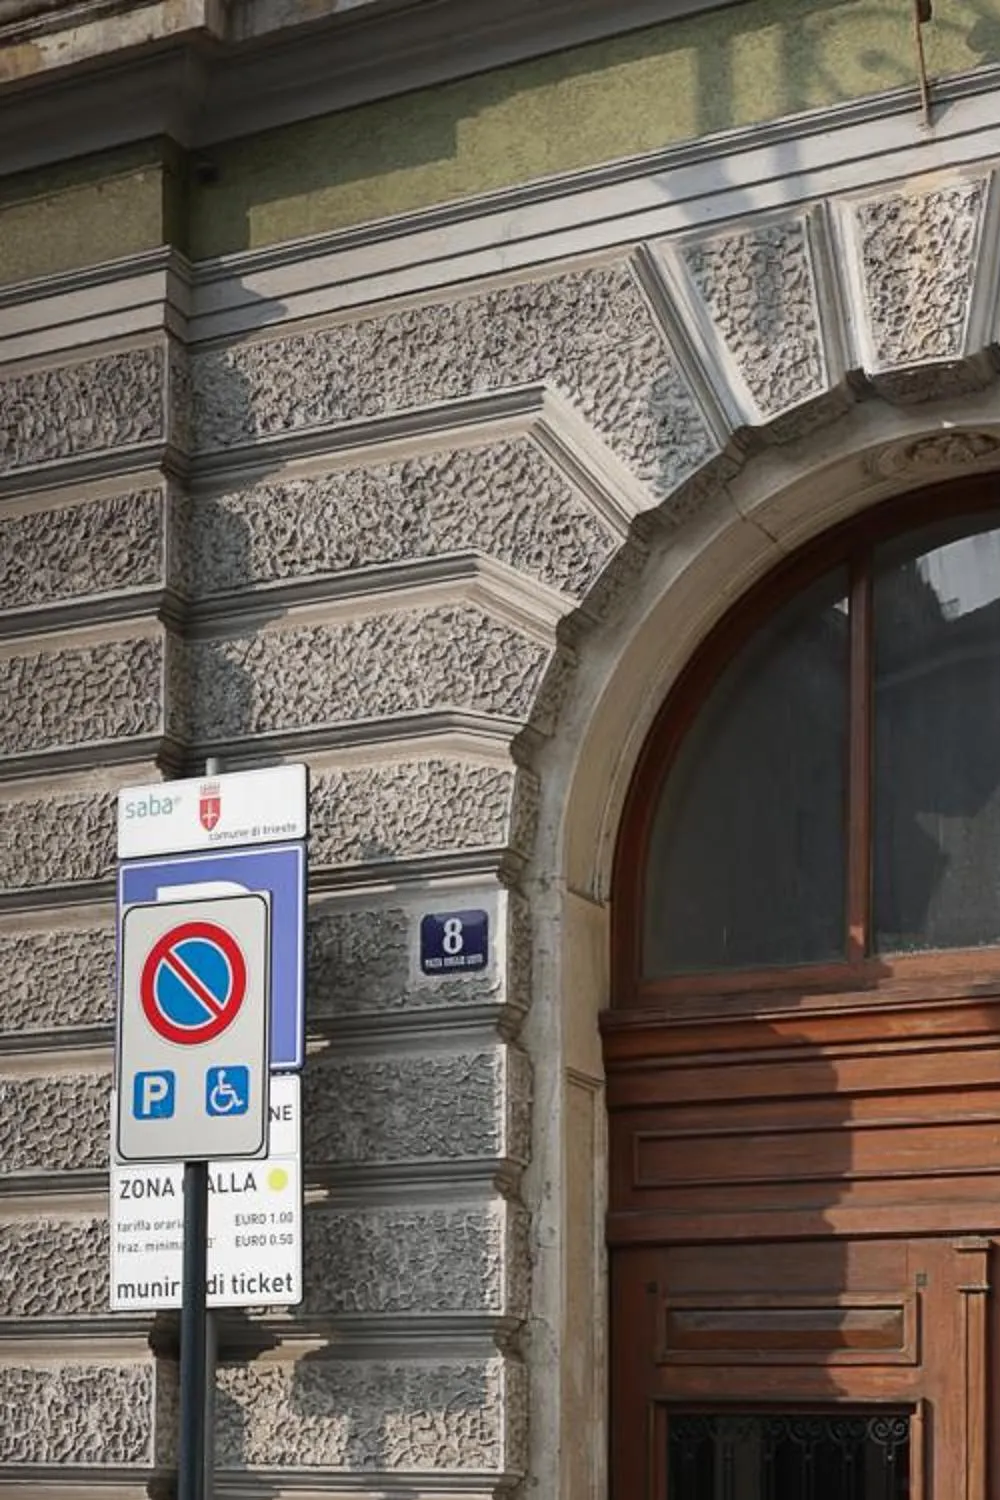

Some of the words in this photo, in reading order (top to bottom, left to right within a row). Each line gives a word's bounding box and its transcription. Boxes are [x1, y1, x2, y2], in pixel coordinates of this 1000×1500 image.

[125, 794, 174, 819] saba
[443, 918, 464, 955] 8
[142, 1076, 169, 1115] P
[269, 1104, 293, 1121] NE
[119, 1177, 175, 1200] ZONA
[154, 1218, 184, 1231] orari
[235, 1212, 266, 1226] EURO
[145, 1240, 184, 1252] minim
[235, 1234, 266, 1249] EURO
[117, 1275, 181, 1300] munir
[206, 1273, 224, 1295] di
[231, 1272, 293, 1295] ticket
